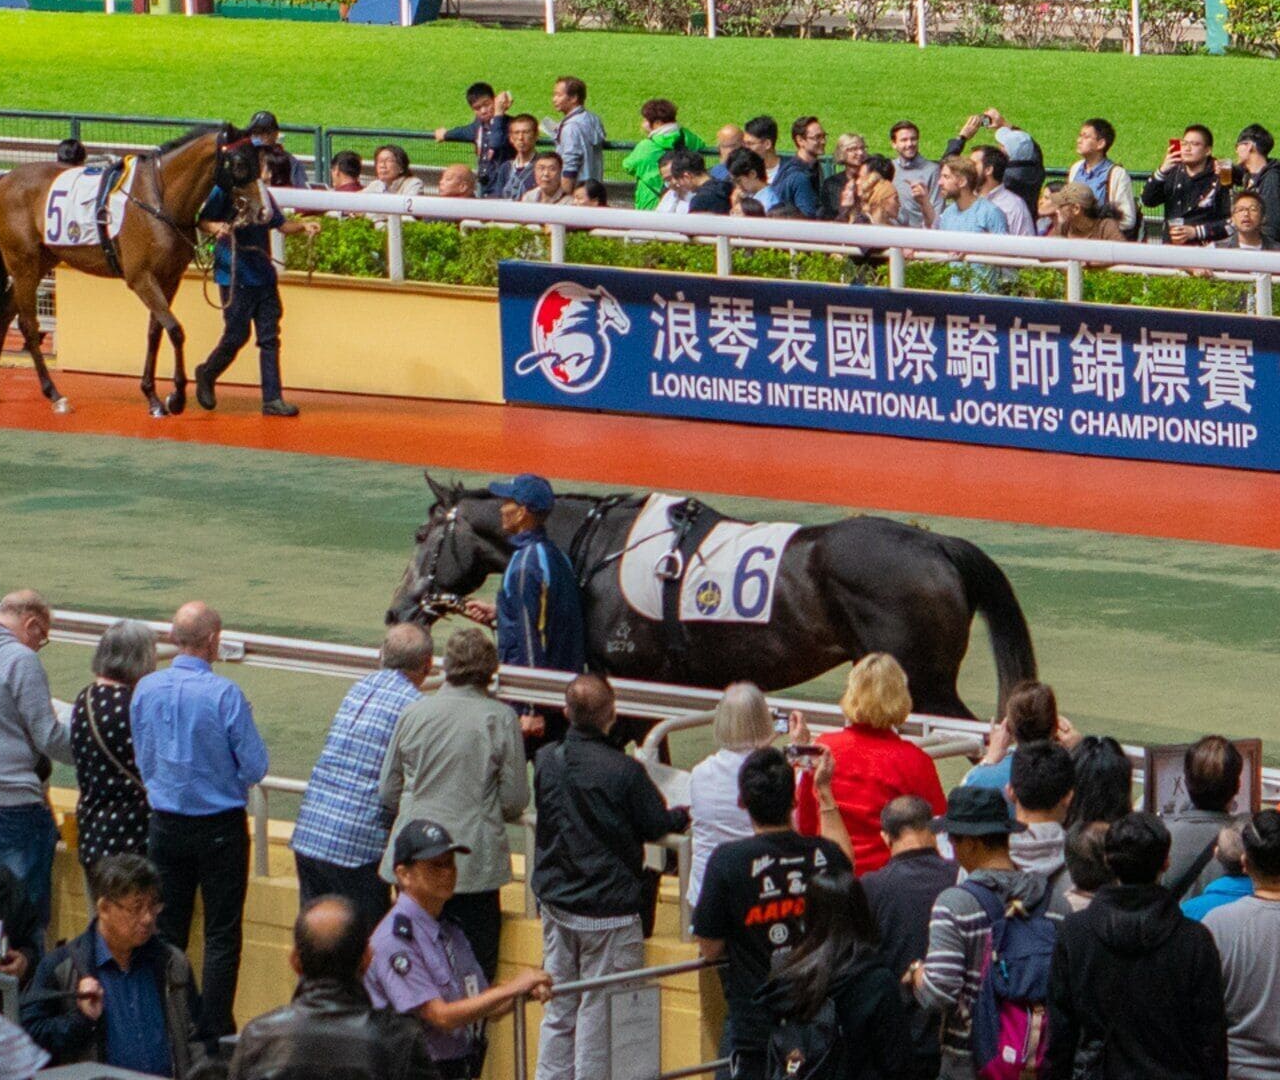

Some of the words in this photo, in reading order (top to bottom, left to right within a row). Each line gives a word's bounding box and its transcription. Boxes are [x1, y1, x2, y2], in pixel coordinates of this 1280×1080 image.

[47, 189, 69, 242] 5
[406, 198, 414, 213] 2
[651, 291, 1257, 414] 浪琴表國際騎師錦標賽
[651, 372, 762, 405] LONGINES
[767, 381, 945, 422] INTERNATIONAL
[950, 398, 1064, 433] JOCKEYS'
[1070, 408, 1258, 449] CHAMPIONSHIP
[732, 545, 776, 618] 6
